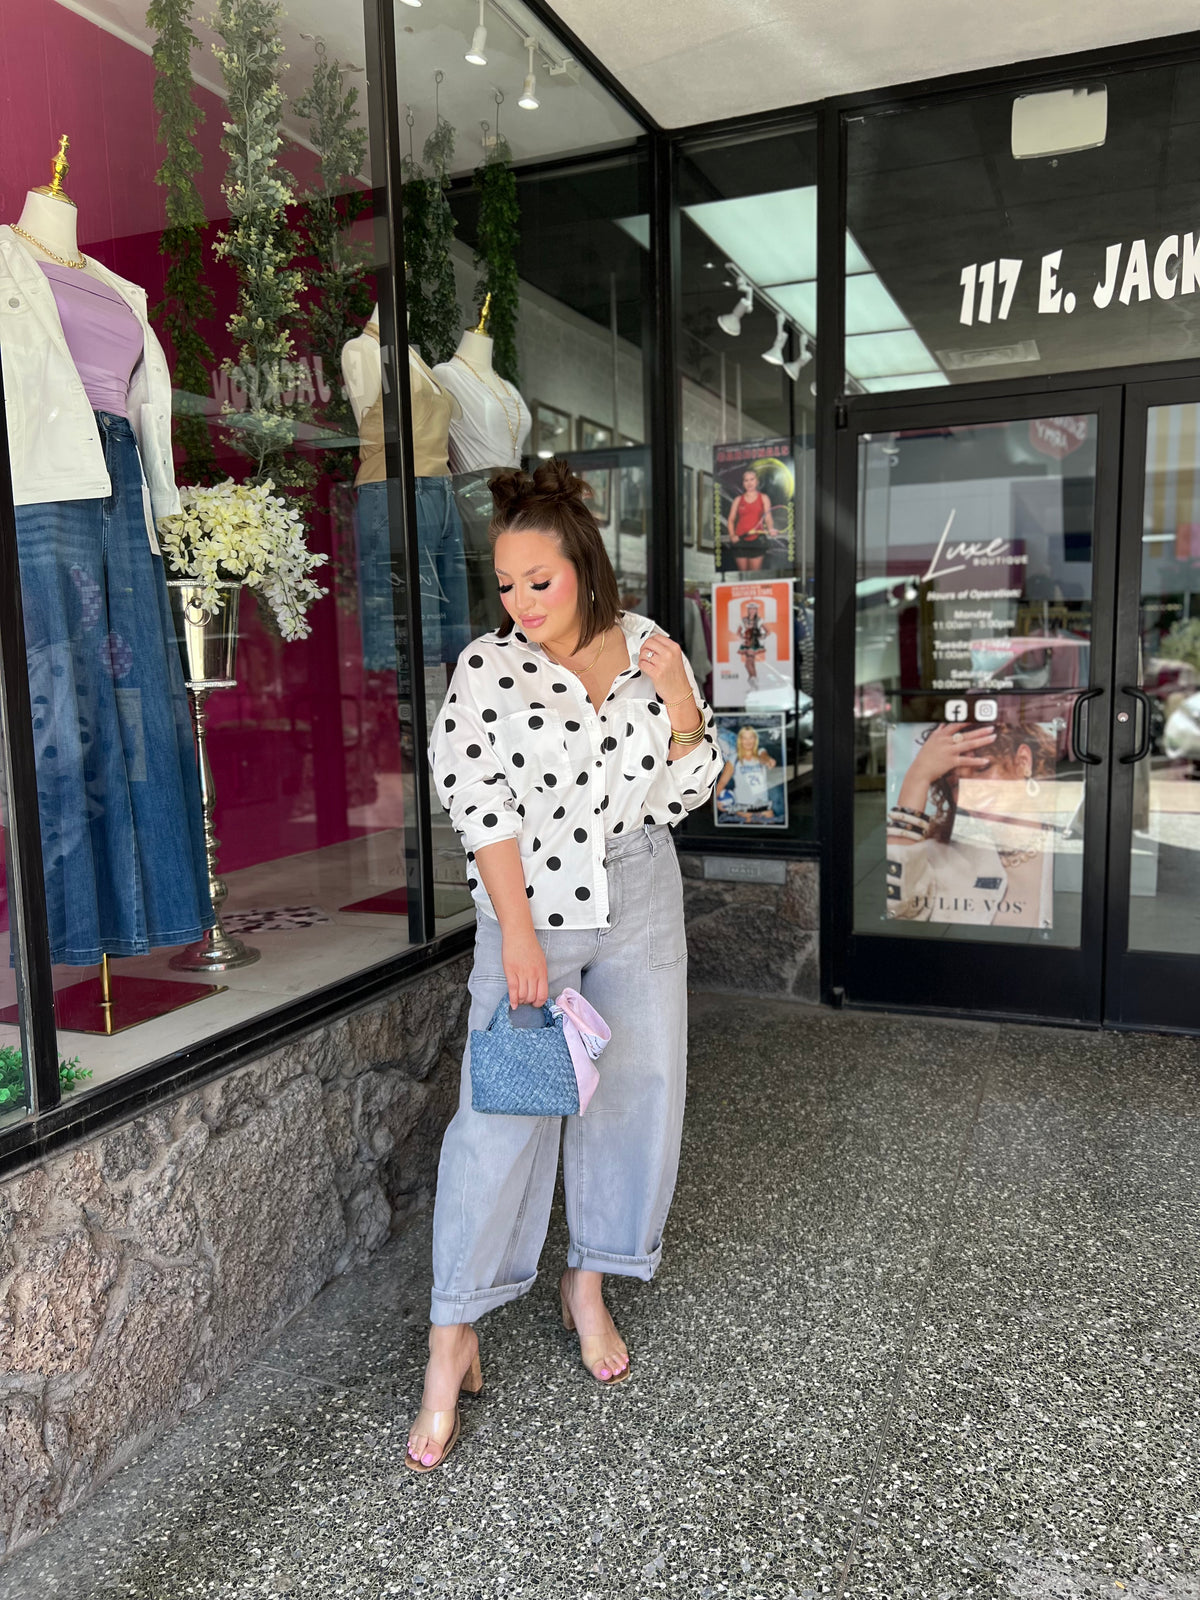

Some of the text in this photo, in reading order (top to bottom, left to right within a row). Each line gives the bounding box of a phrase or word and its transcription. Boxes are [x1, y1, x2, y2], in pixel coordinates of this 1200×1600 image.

[959, 257, 1023, 326] 117
[1038, 249, 1076, 314] E.
[921, 508, 1010, 582] Luxe
[973, 555, 1028, 567] BOUTIQUE
[926, 590, 956, 601] Hours
[957, 589, 969, 600] of
[953, 610, 994, 620] Monday
[911, 895, 1024, 915] JULIE VOS
